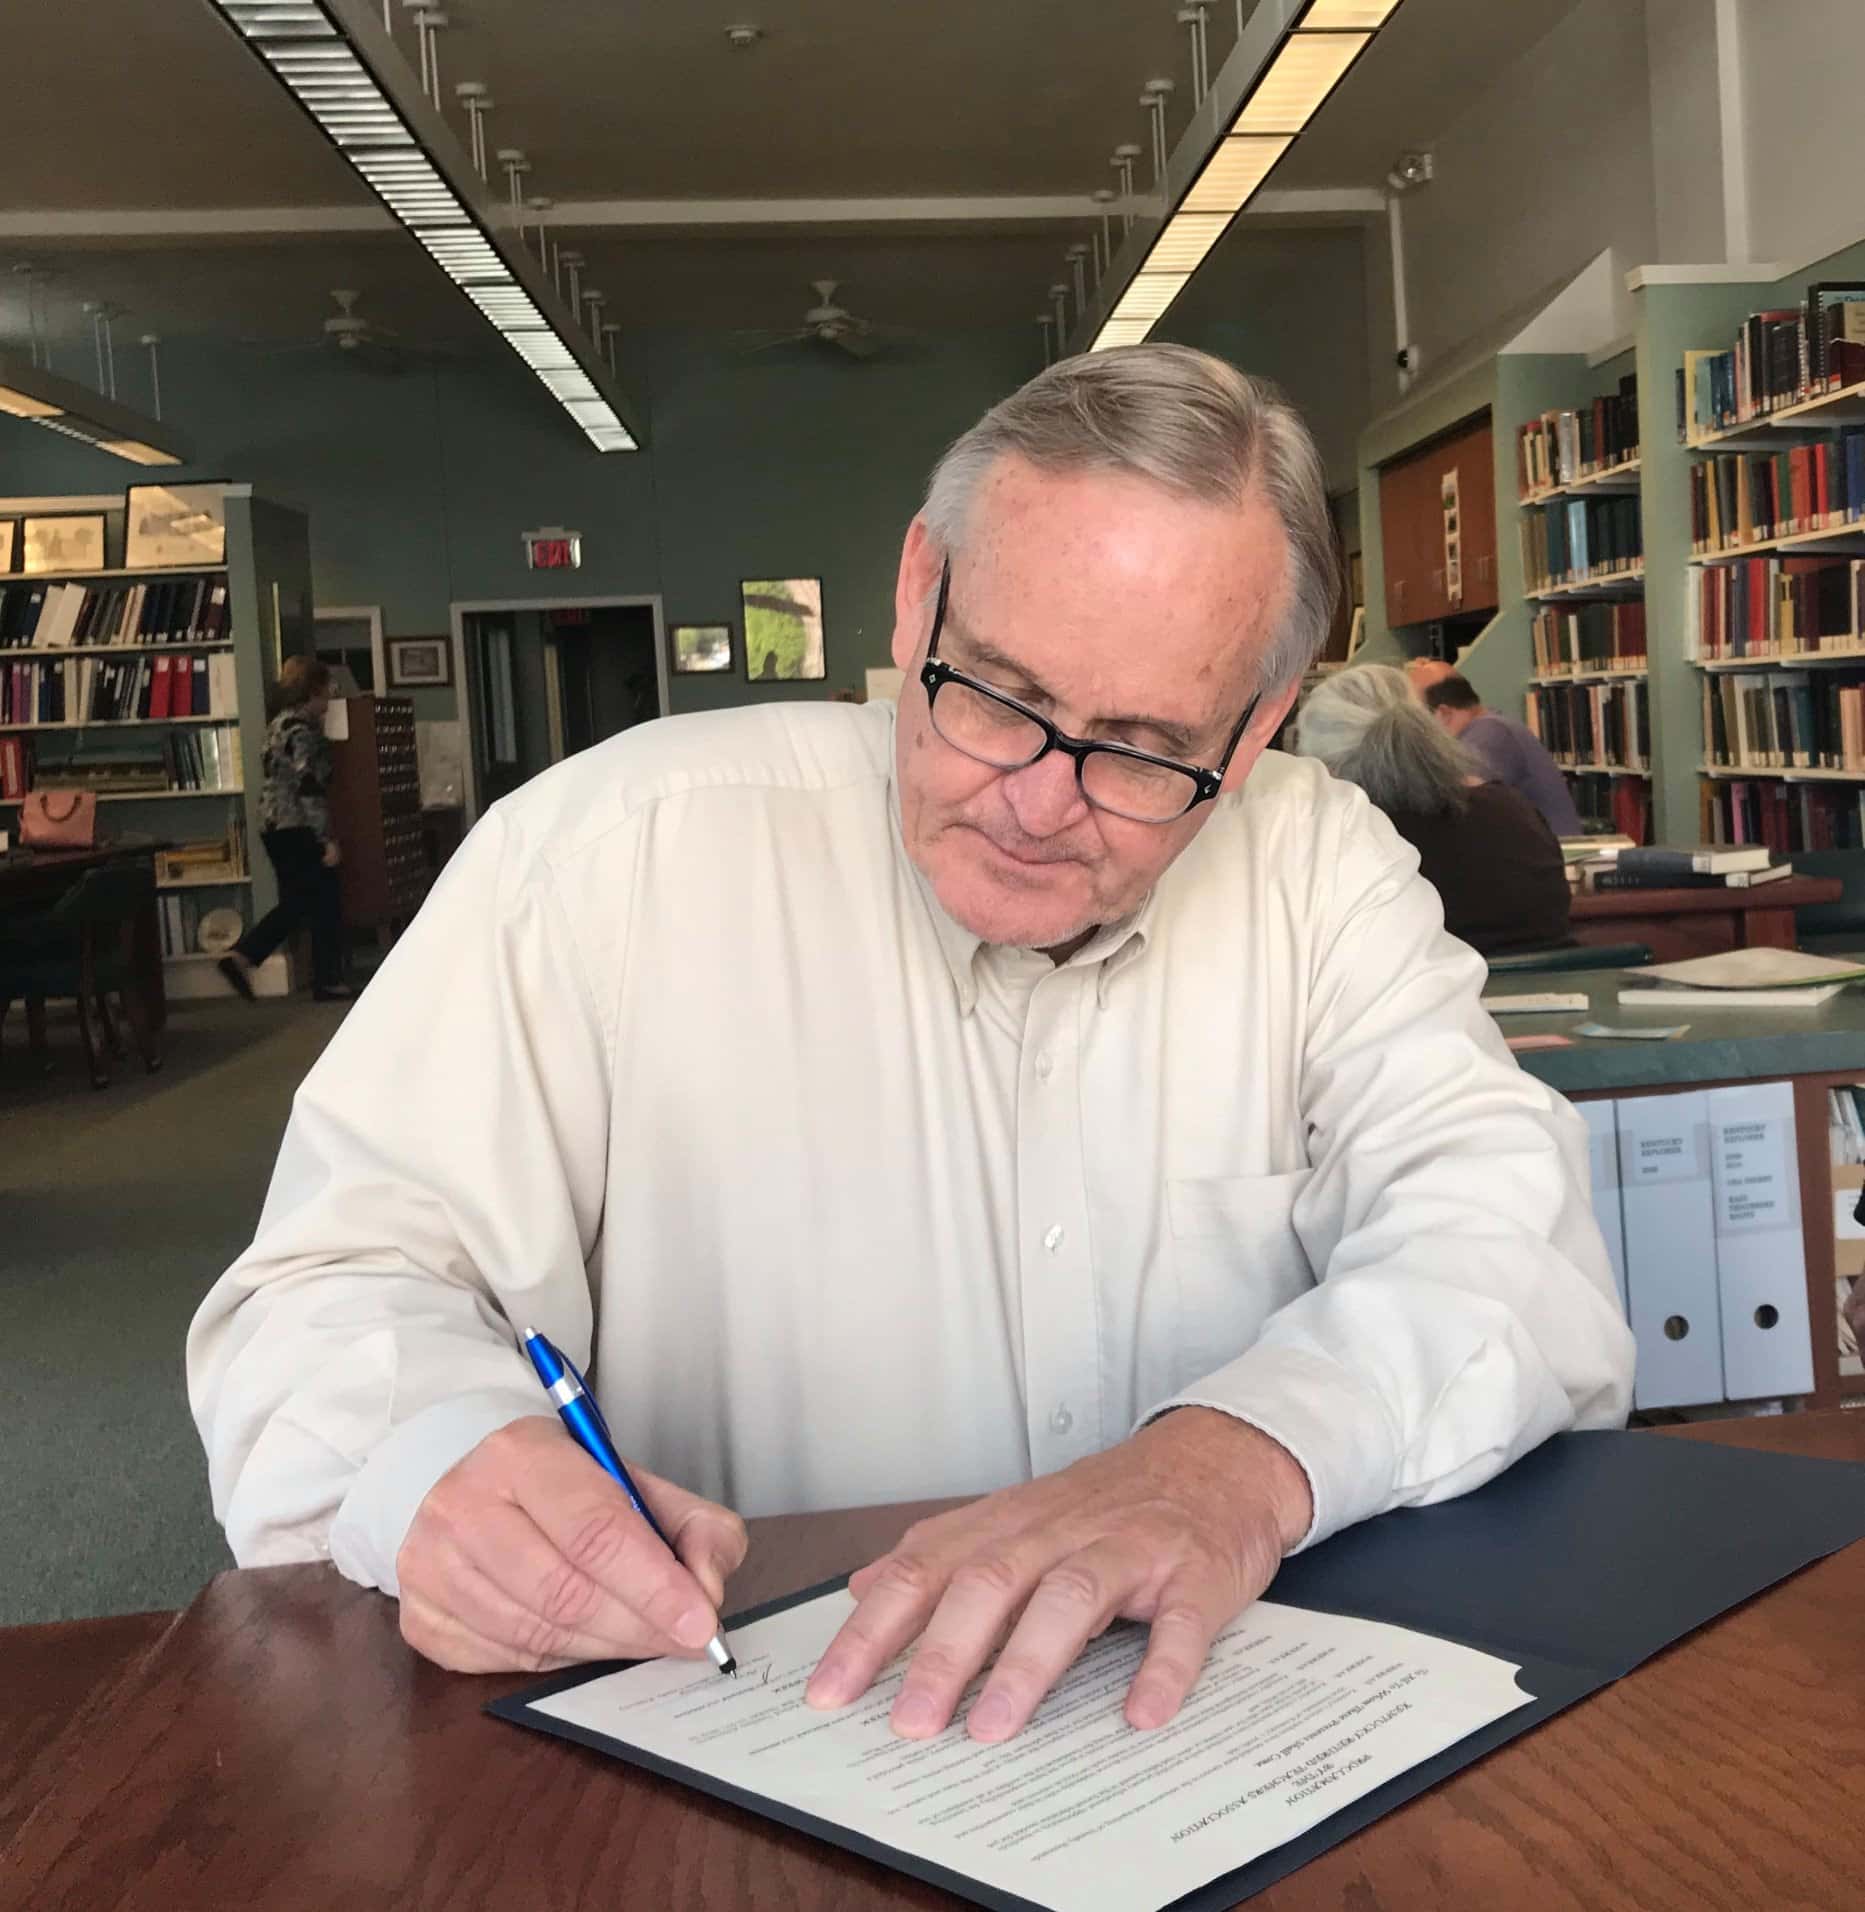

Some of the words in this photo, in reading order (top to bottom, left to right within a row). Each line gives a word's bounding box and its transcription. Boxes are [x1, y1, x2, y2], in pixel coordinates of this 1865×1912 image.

[534, 540, 570, 568] EXIT
[1354, 1702, 1413, 1739] KENTUCKY
[1280, 1738, 1304, 1756] Shall
[1305, 1734, 1355, 1766] RETIRED
[1247, 1761, 1309, 1799] TEACHERS
[1285, 1754, 1372, 1806] PROCLAMATION
[1170, 1796, 1247, 1843] ASSOCIATION
